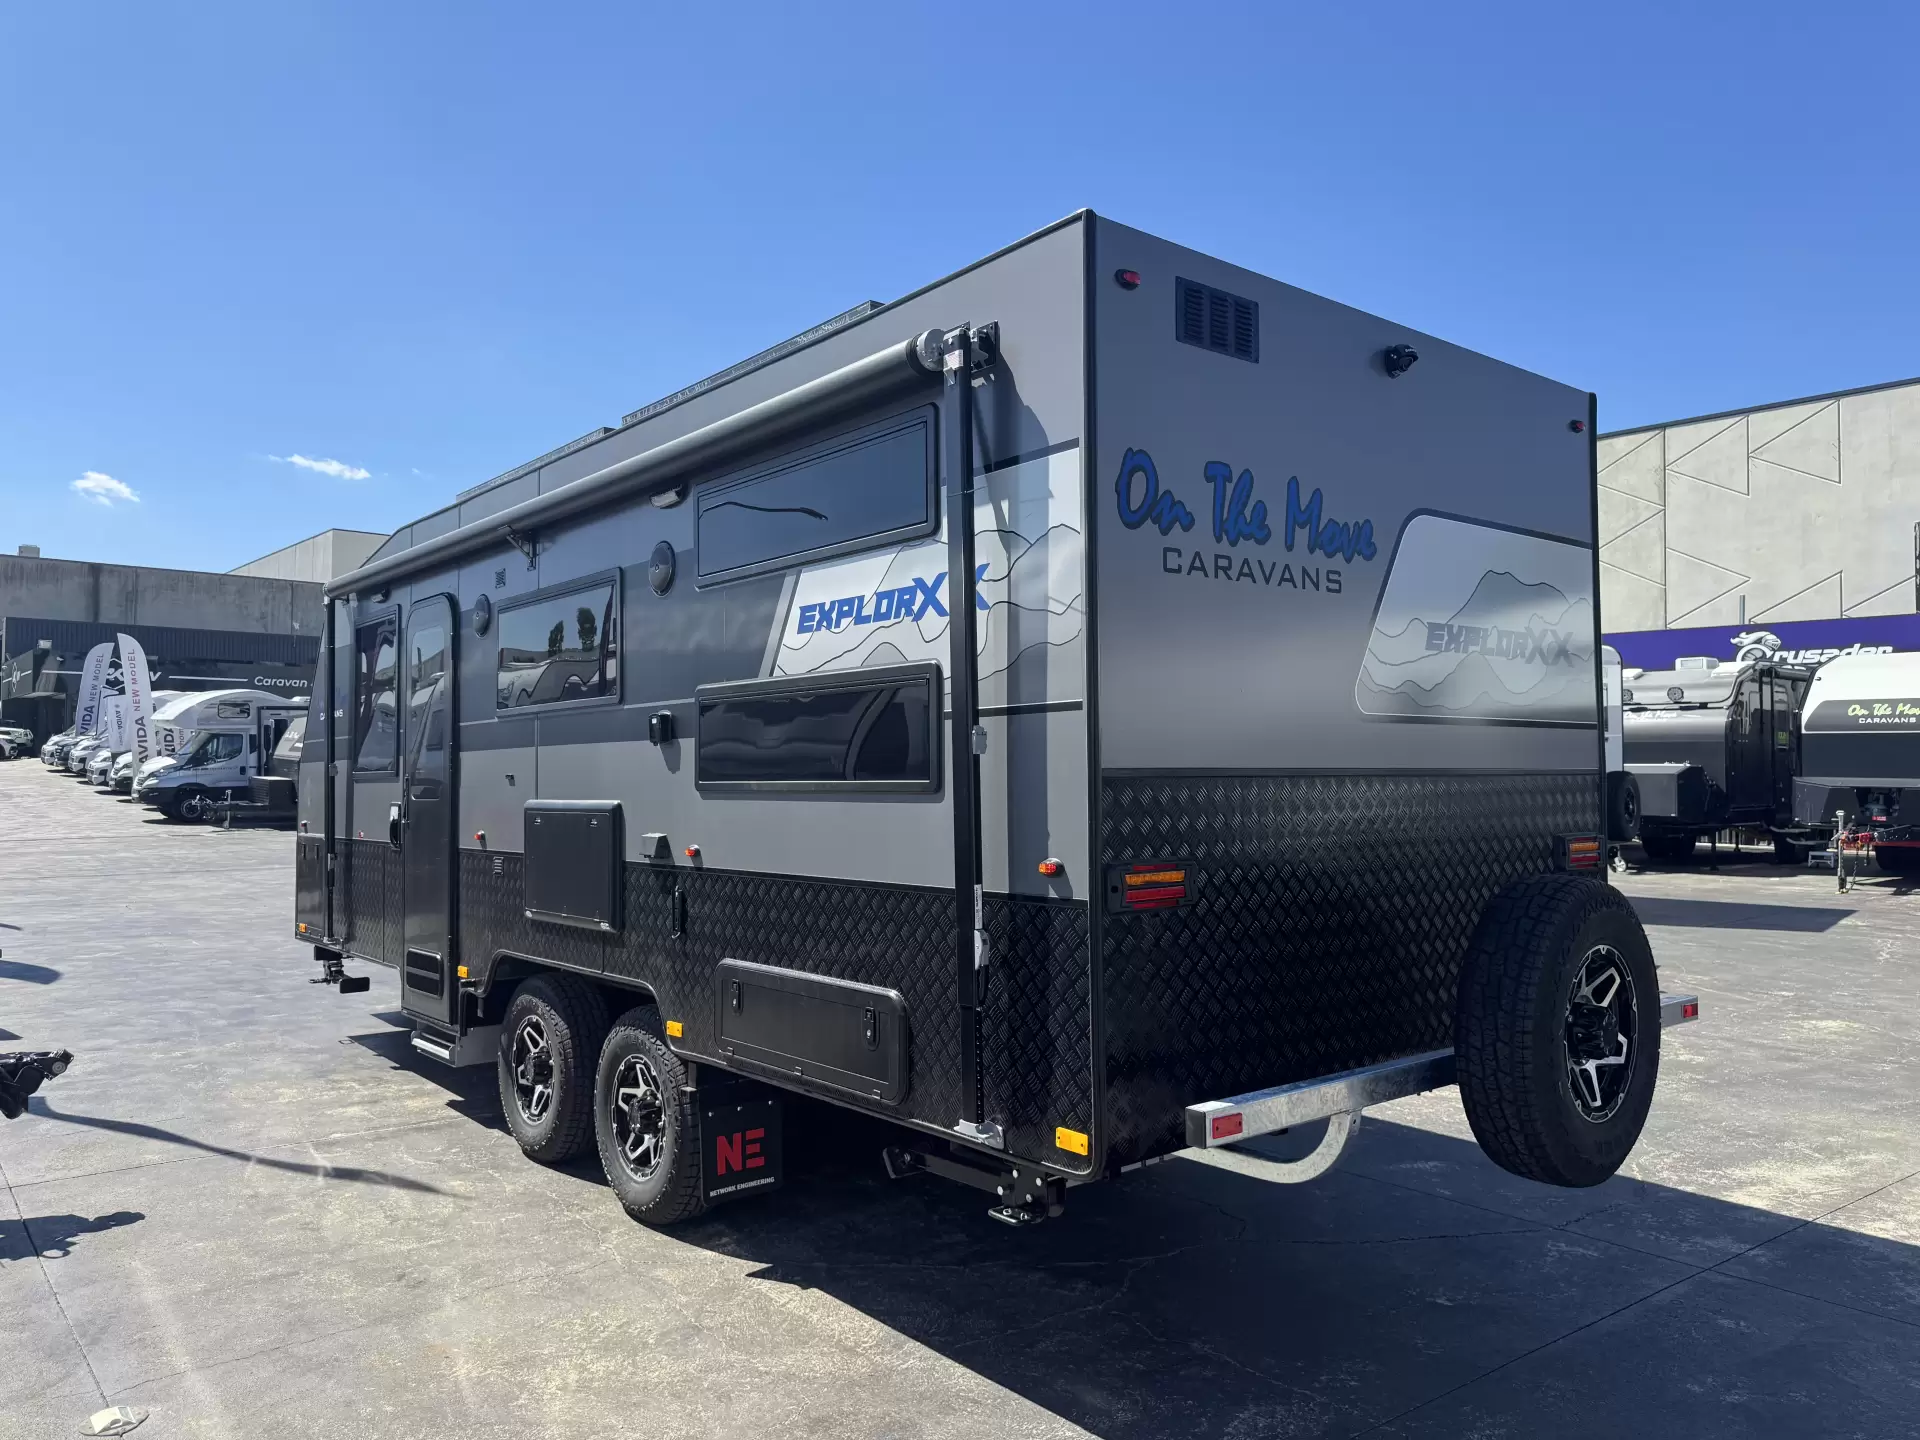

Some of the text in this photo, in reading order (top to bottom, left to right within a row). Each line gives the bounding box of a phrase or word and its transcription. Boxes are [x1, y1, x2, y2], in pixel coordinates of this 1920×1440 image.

[1115, 447, 1377, 564] On The Move
[1162, 547, 1343, 594] CARAVANS
[1424, 621, 1575, 668] EXPLORXX
[88, 683, 98, 702] NEW
[93, 654, 104, 682] MODEL
[254, 675, 308, 688] Caravan
[128, 649, 149, 763] AVIDA NEW MODEL
[1847, 704, 1869, 716] On
[1872, 703, 1892, 716] The
[716, 1127, 765, 1176] NE
[709, 1176, 775, 1197] NETWORK ENGINEERING
